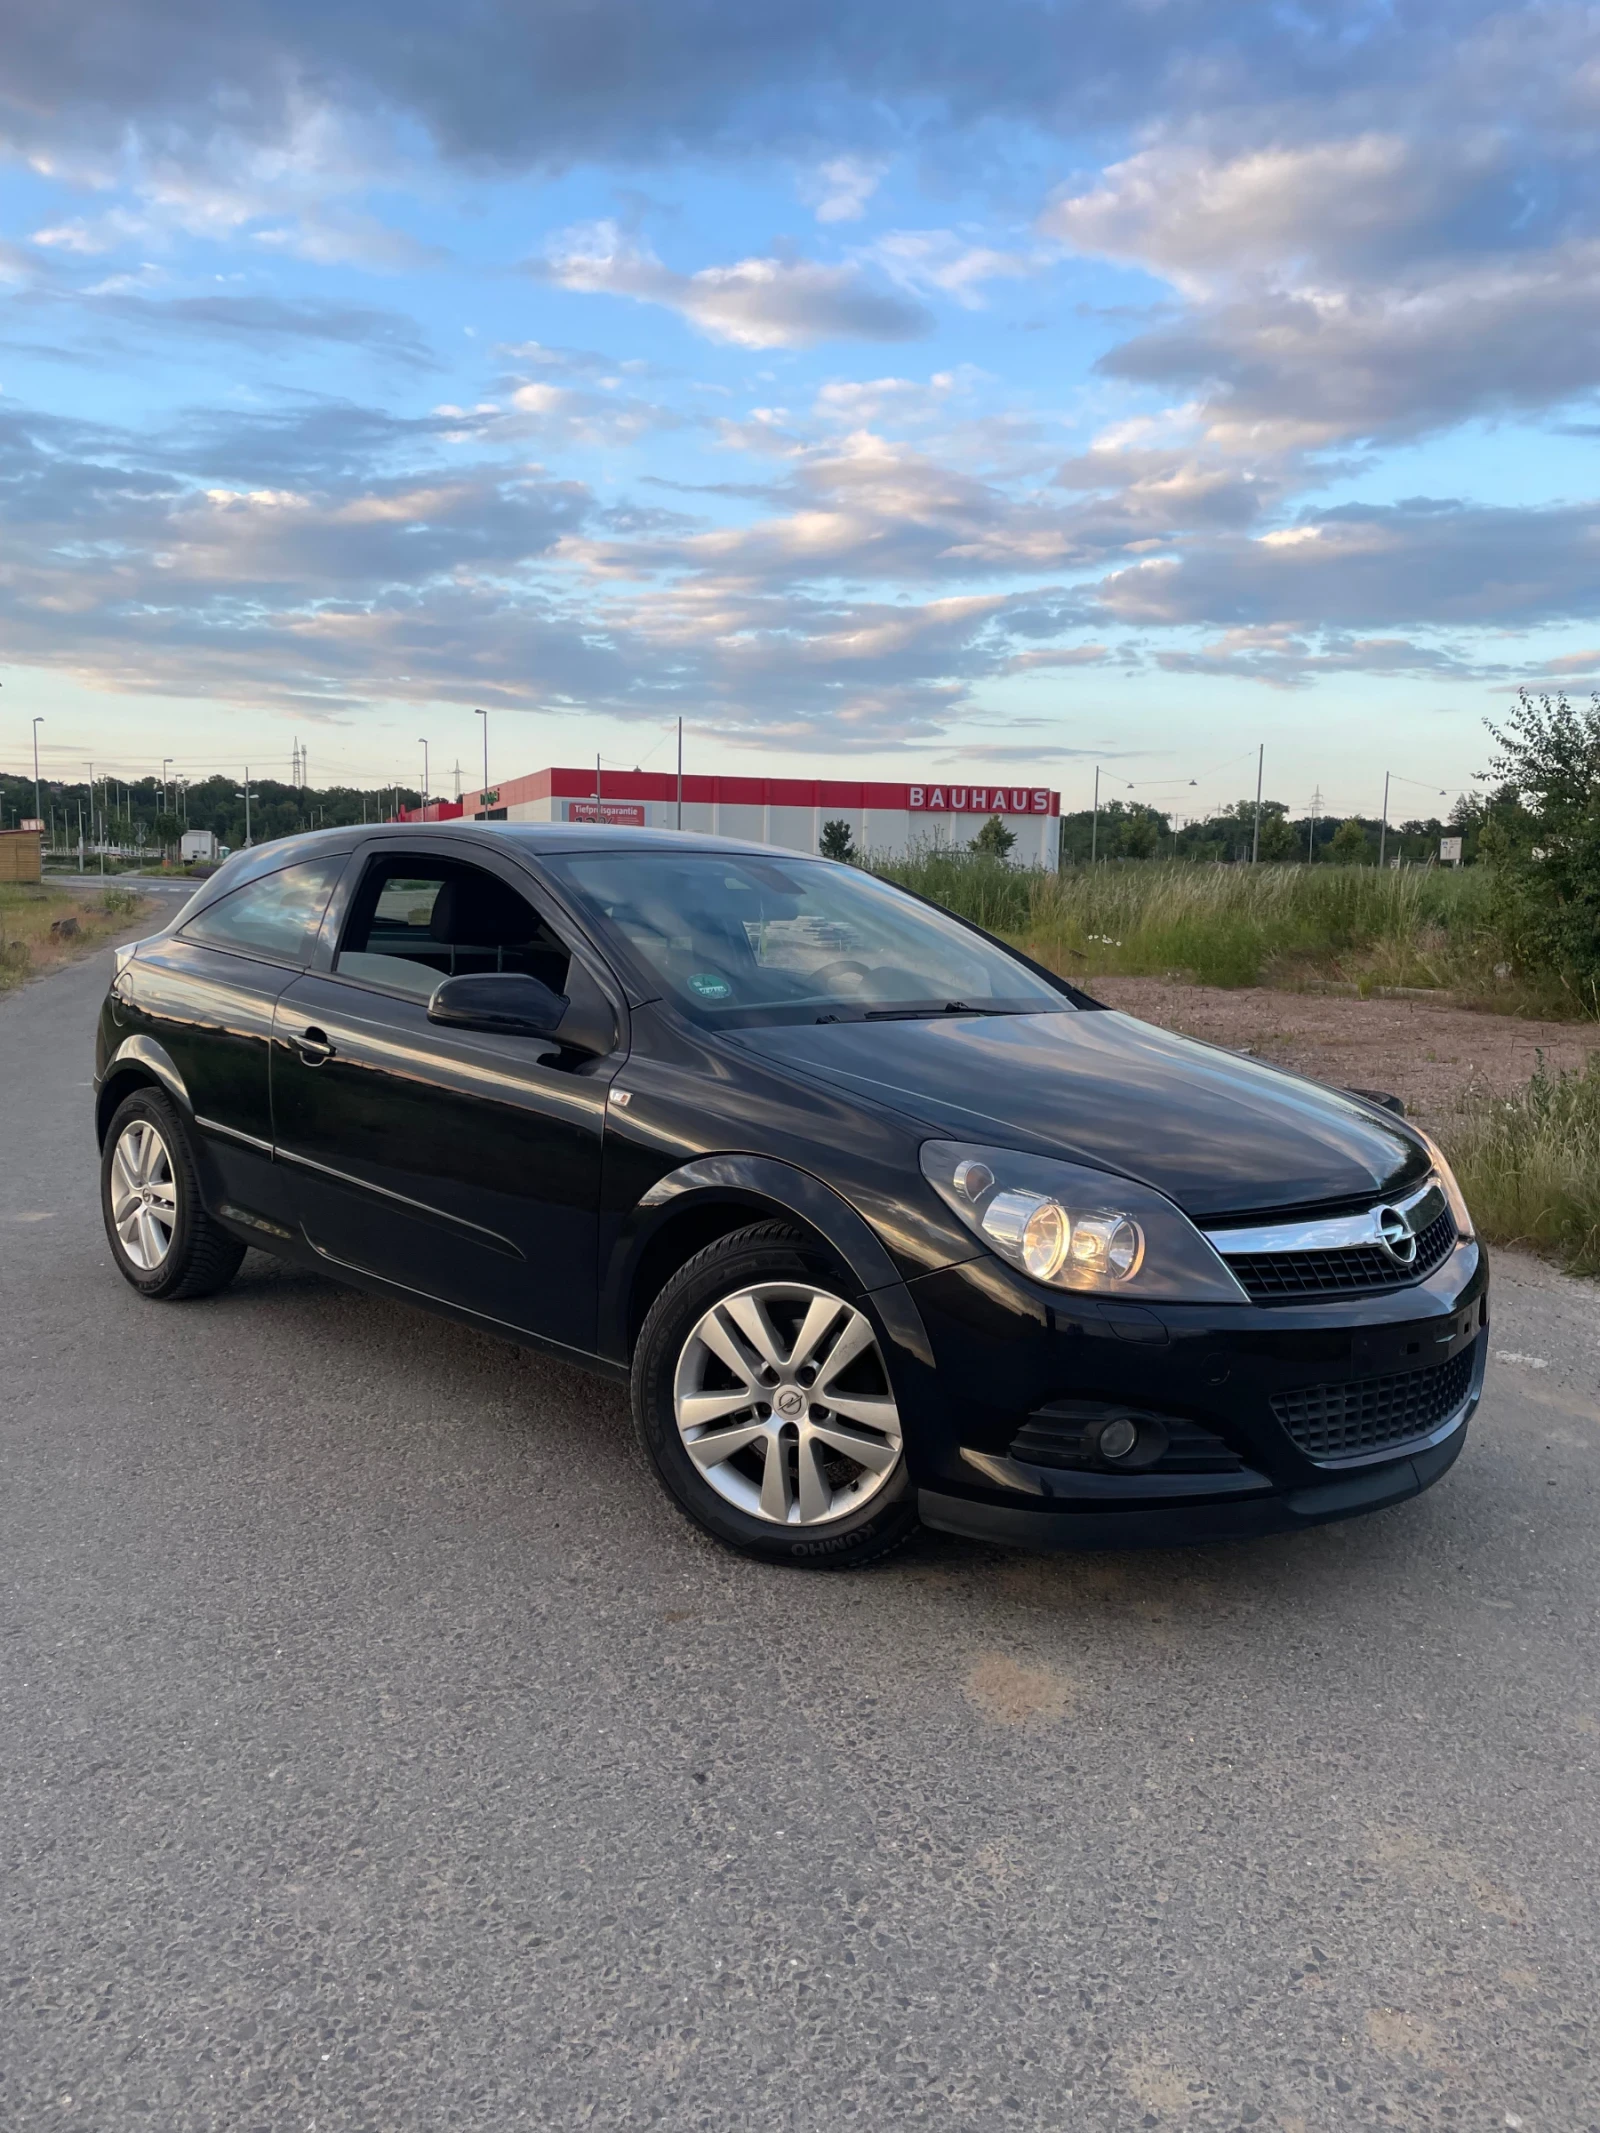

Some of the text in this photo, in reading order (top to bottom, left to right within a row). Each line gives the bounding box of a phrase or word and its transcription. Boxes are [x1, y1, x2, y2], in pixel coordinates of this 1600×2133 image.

[574, 804, 639, 816] Tiefprisgarantie
[909, 787, 1048, 810] BAUHAUS
[791, 1523, 876, 1556] KUMHO
